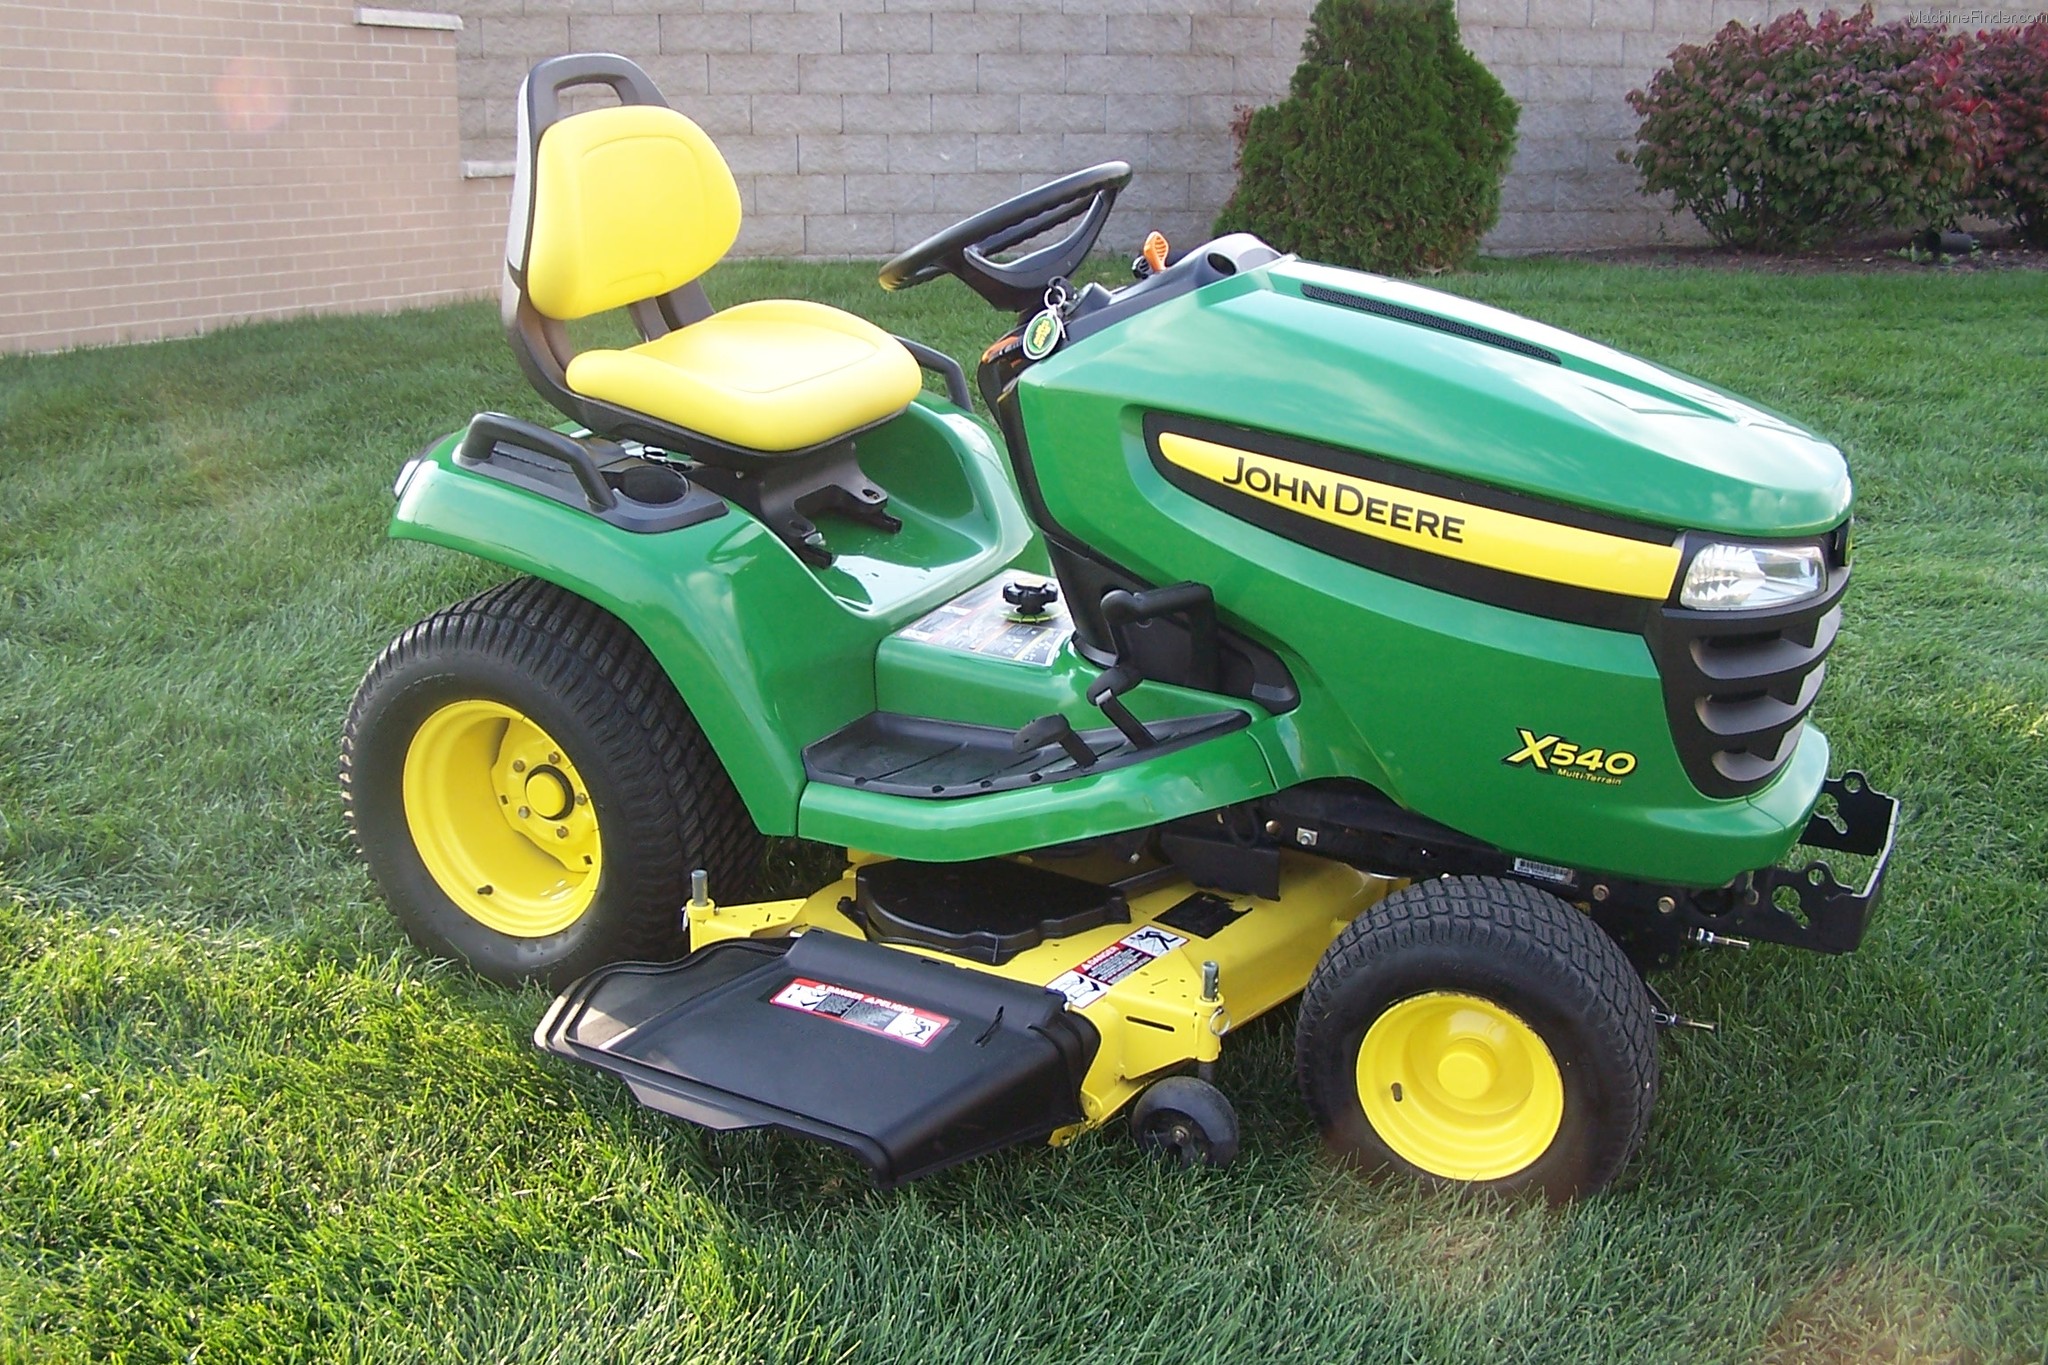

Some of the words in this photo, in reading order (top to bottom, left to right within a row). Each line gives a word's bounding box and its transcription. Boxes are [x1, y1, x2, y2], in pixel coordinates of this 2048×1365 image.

[1222, 456, 1327, 510] JOHN
[1333, 482, 1466, 544] DEERE
[1502, 727, 1638, 775] X540
